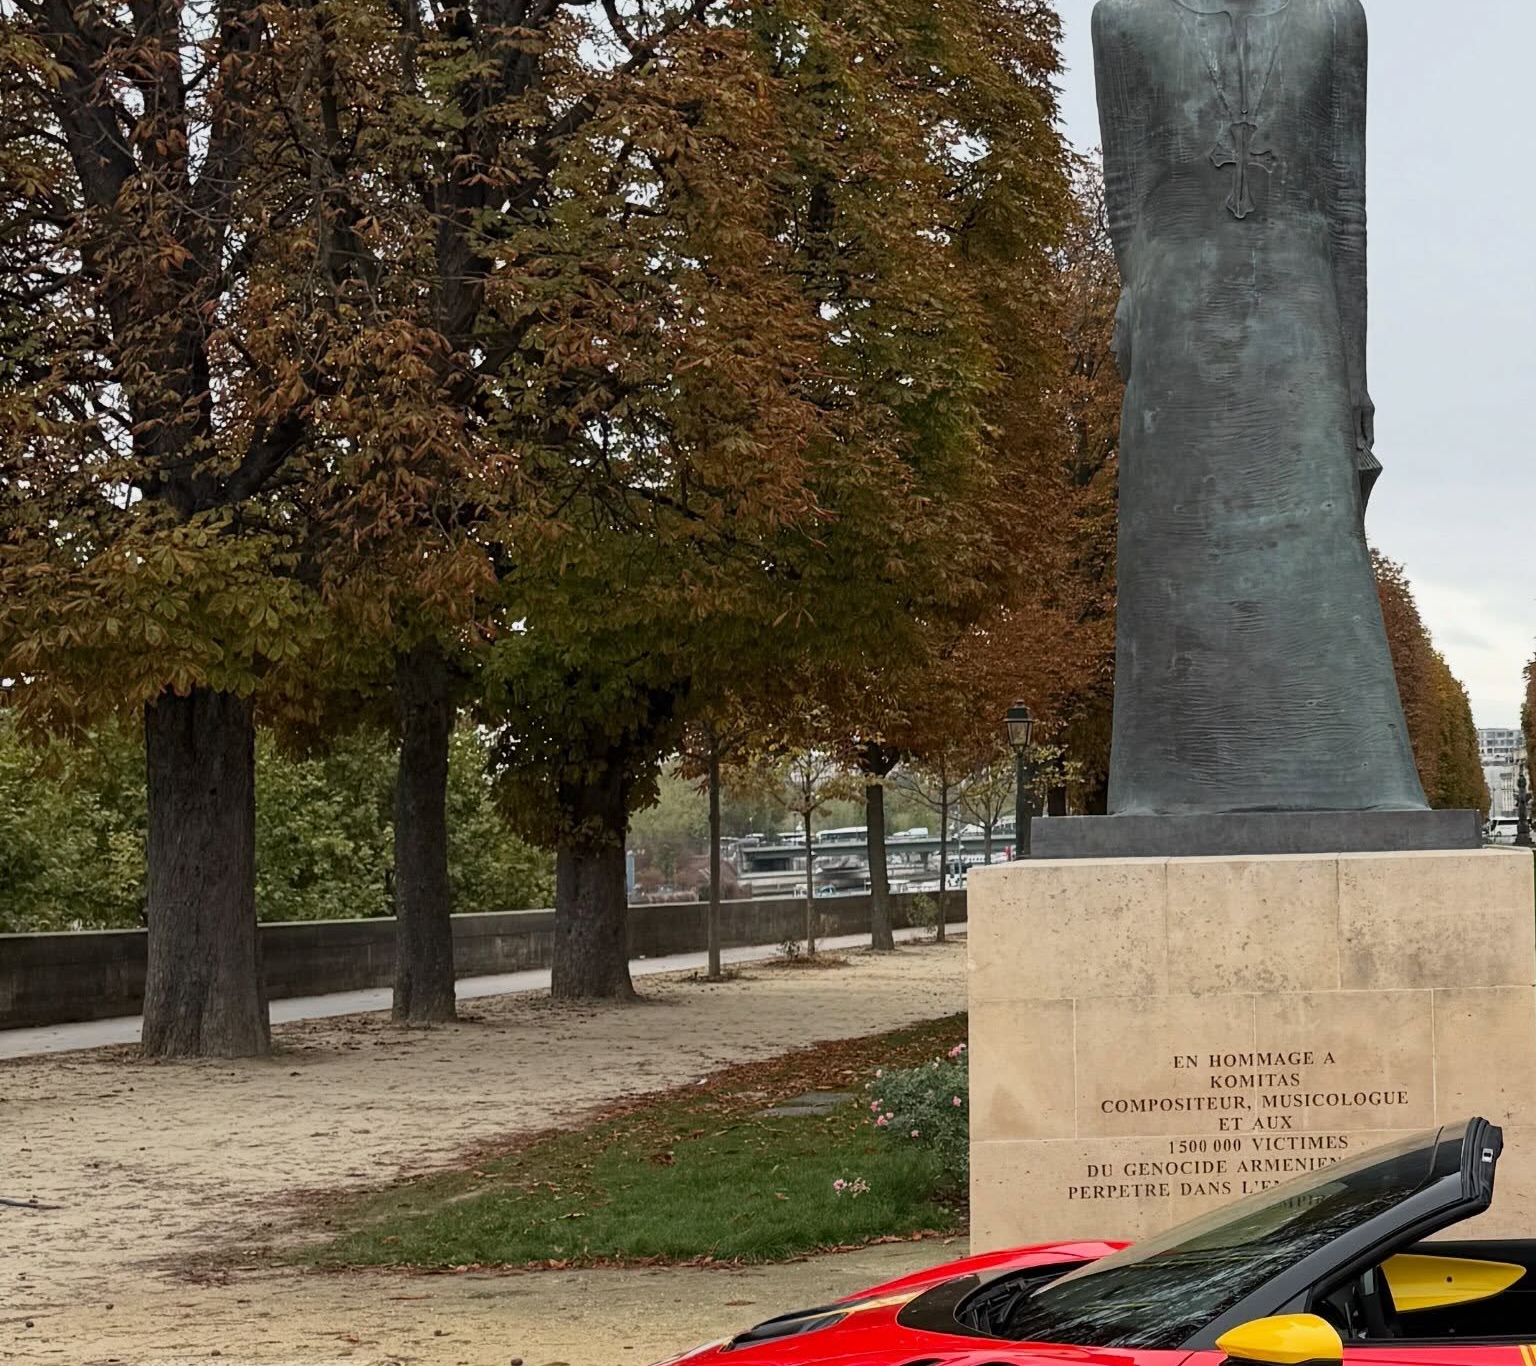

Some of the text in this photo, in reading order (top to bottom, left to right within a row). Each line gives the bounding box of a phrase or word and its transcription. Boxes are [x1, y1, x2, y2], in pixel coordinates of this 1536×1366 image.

[1173, 1051, 1336, 1069] EN HOMMAGE A
[1210, 1072, 1300, 1089] KOMITAS
[1100, 1090, 1409, 1114] COMPOSITEUR, MUSICOLOGUE
[1218, 1115, 1293, 1132] ET AUX
[1251, 1135, 1349, 1152] VICTIMES
[1087, 1163, 1113, 1178] DU
[1123, 1160, 1228, 1177] GENOCIDE
[1068, 1183, 1171, 1200] PERPETRE
[1180, 1181, 1232, 1197] DANS
